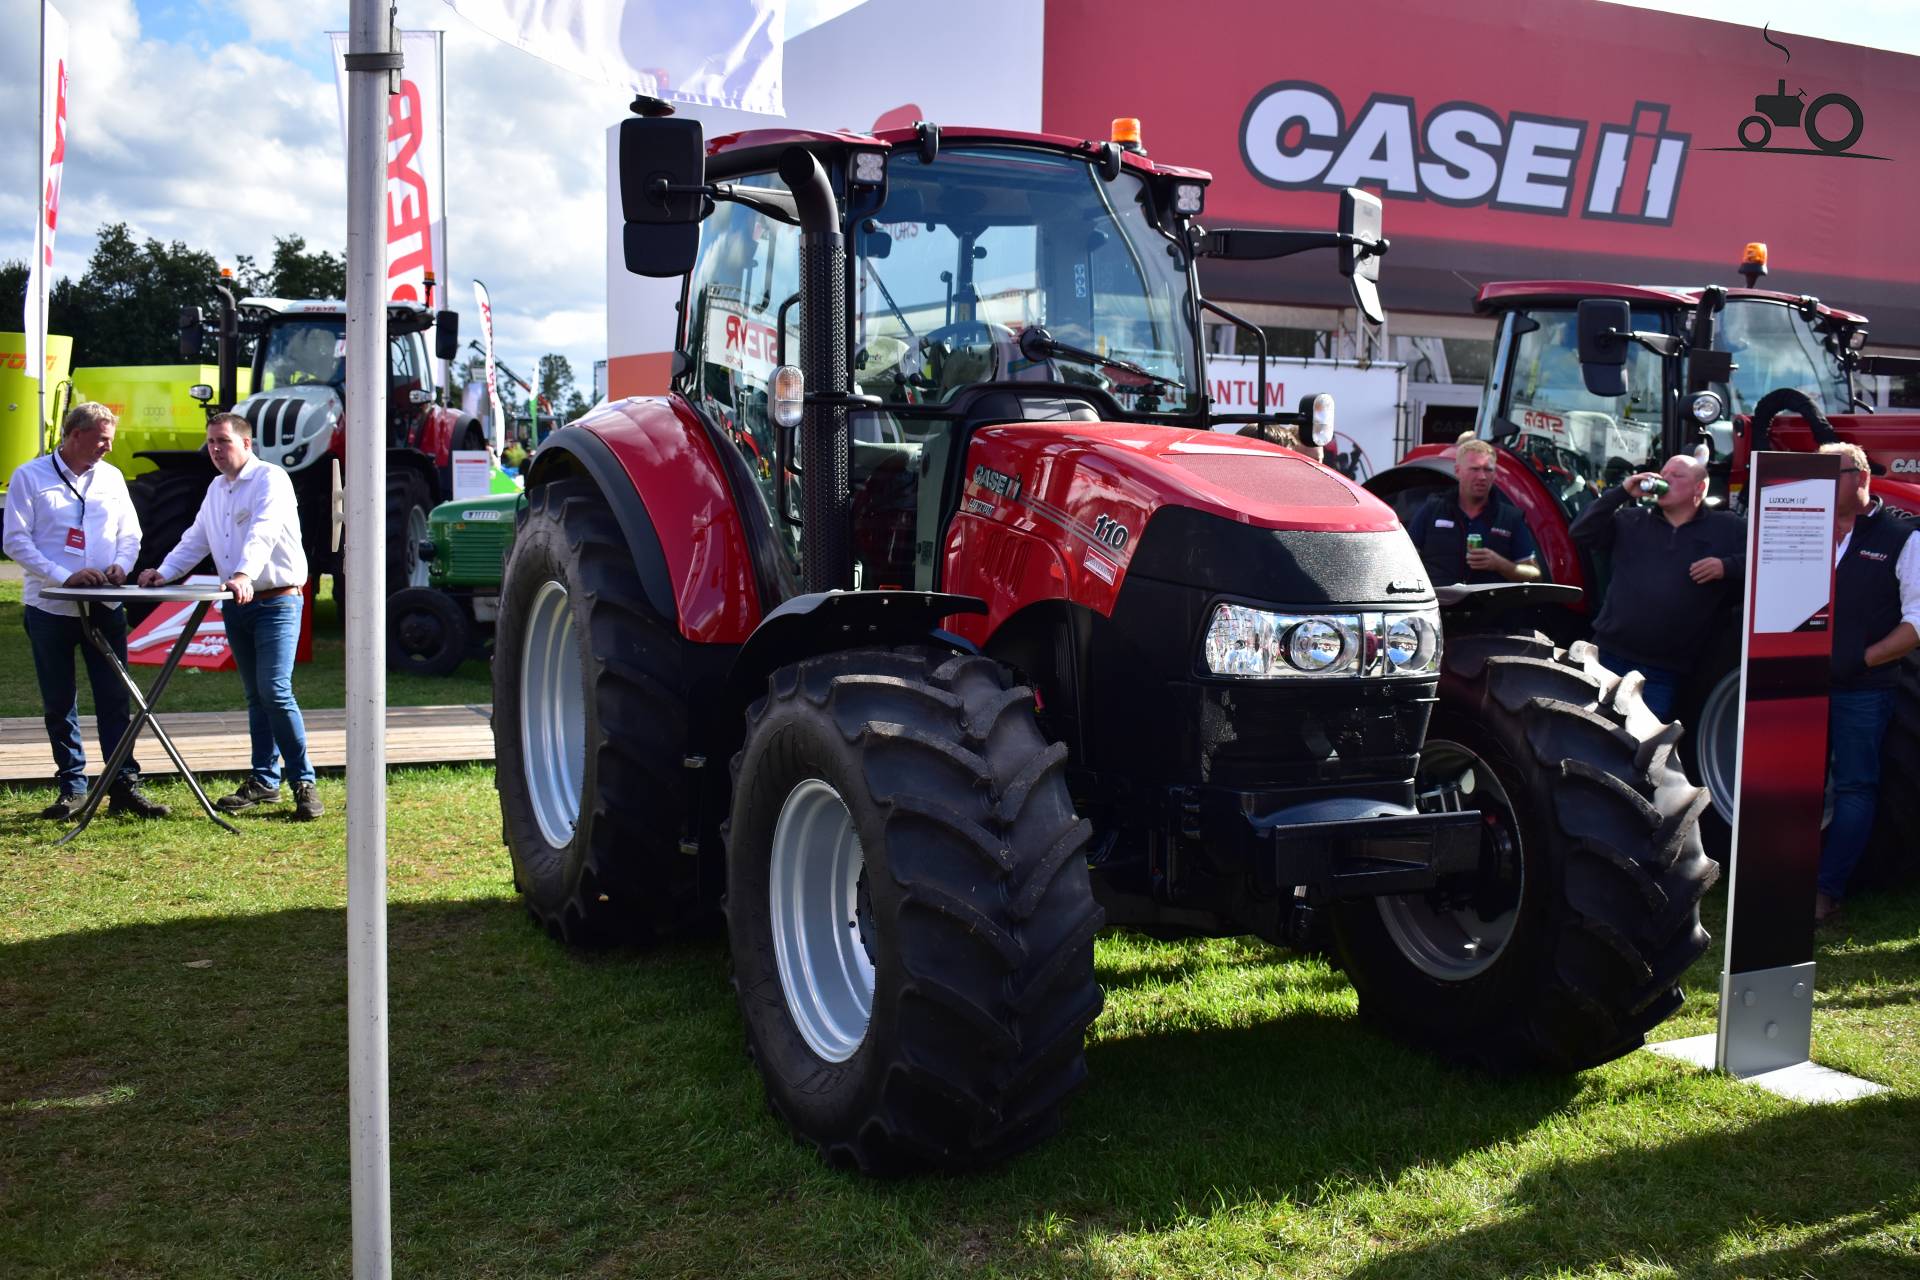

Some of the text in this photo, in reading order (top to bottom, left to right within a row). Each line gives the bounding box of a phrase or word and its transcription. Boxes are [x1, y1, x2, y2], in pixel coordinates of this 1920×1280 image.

[1238, 80, 1588, 217] CASE
[973, 464, 1008, 498] CASE
[1891, 458, 1920, 473] CA
[1093, 513, 1128, 550] 110
